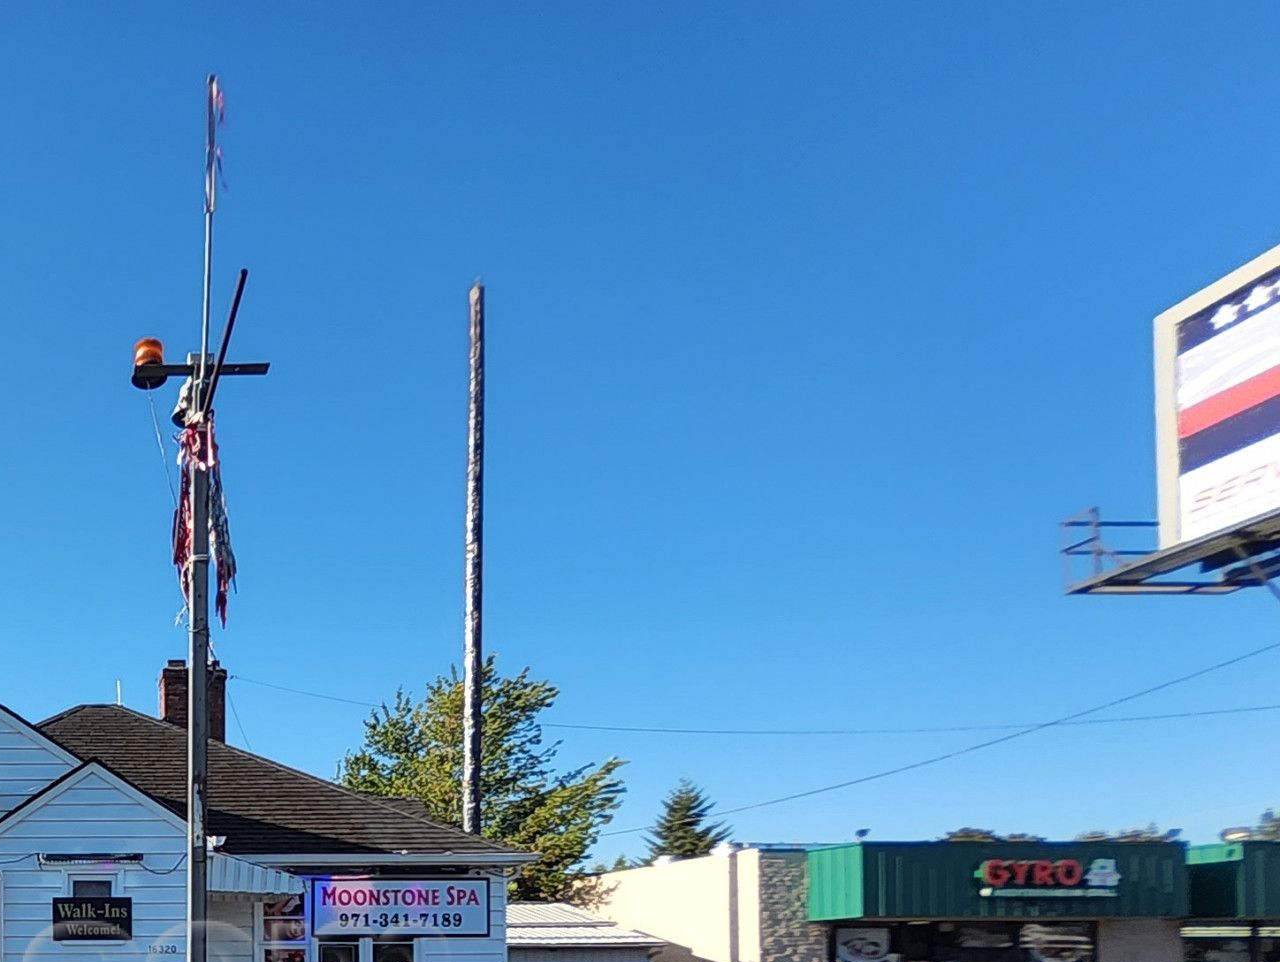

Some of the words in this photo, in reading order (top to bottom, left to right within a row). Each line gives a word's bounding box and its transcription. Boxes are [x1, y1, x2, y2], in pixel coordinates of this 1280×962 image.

[982, 858, 1083, 886] GYRO
[321, 886, 441, 906] MOONSTONE
[446, 886, 480, 906] SPA
[57, 903, 128, 919] Walk-Ins
[339, 913, 463, 928] 971-341-7189
[65, 924, 121, 936] Welcome!
[148, 945, 177, 954] 16320
